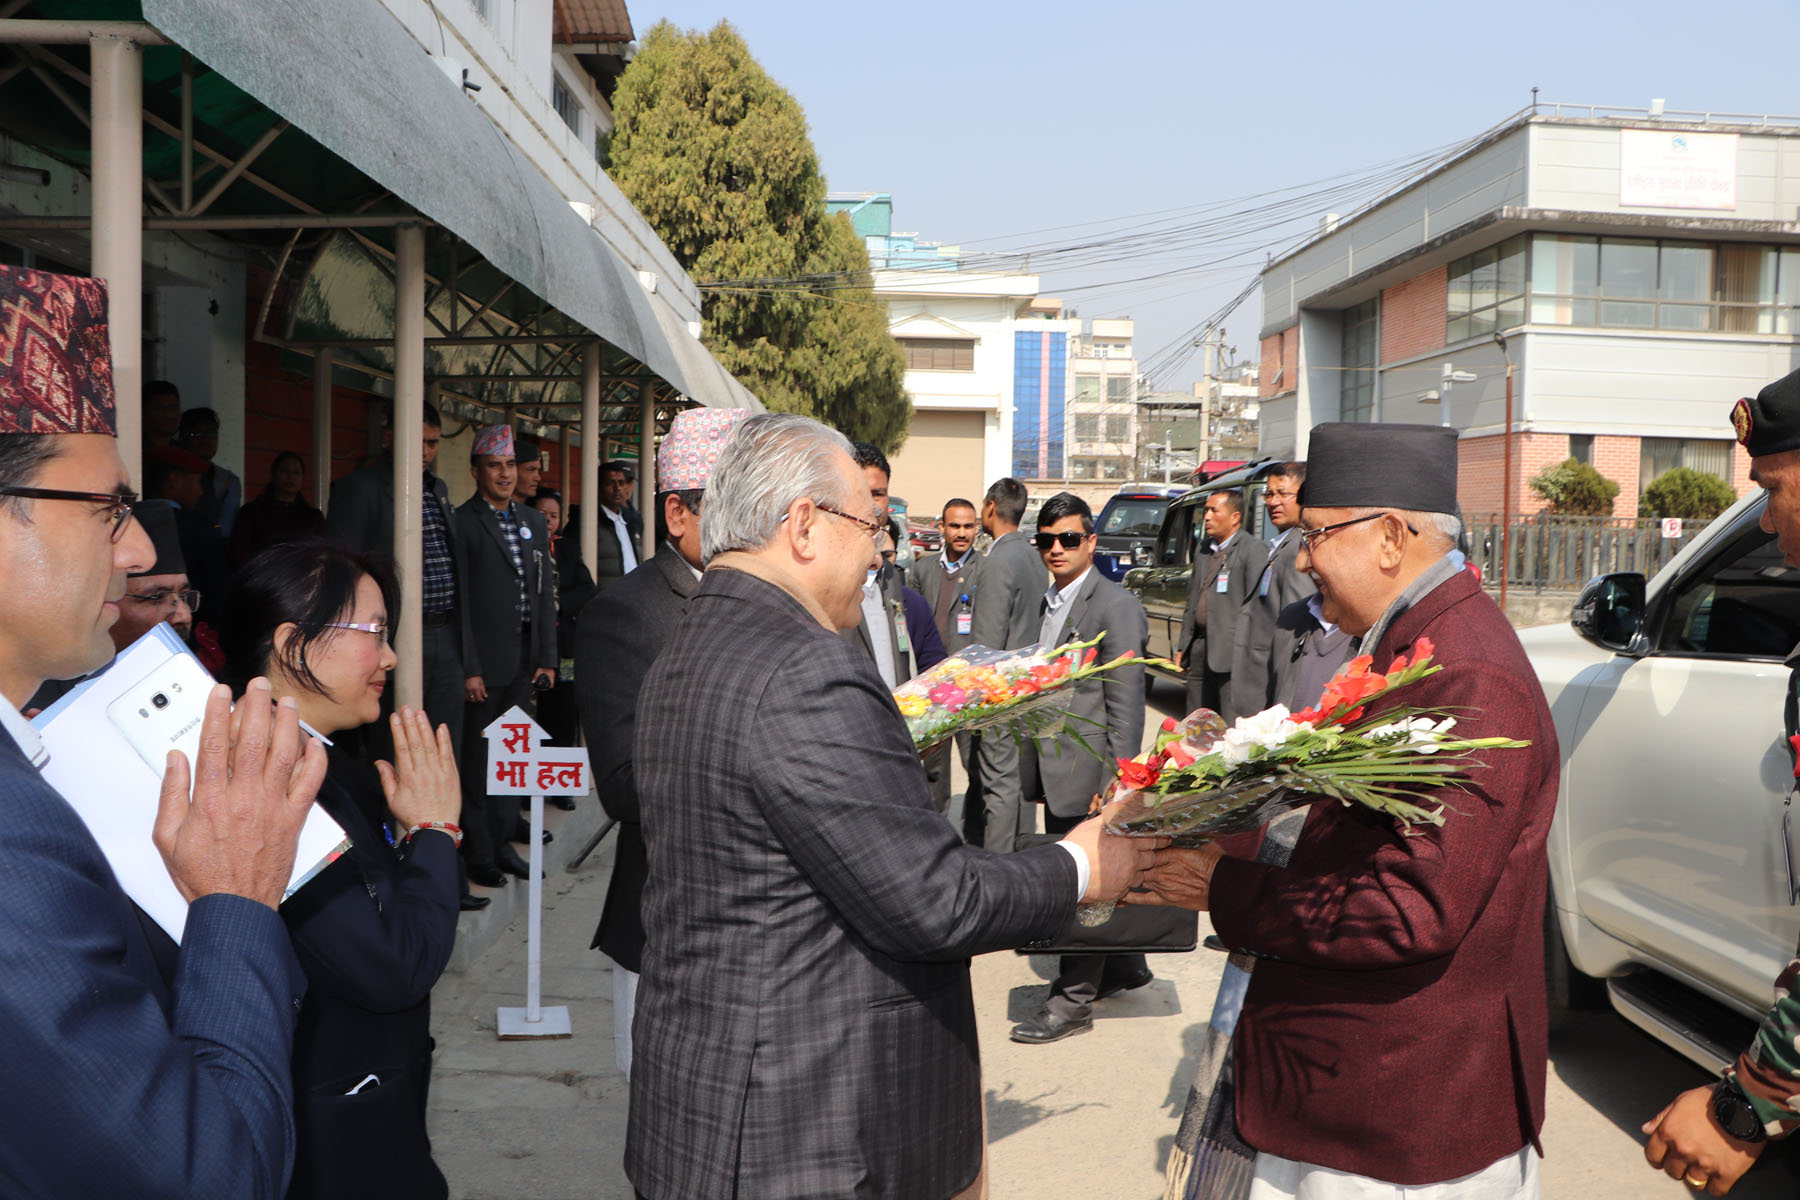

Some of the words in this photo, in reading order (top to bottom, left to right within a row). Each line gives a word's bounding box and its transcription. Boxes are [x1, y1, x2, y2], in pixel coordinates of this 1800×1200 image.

[170, 717, 201, 742] SAMSUNG
[501, 723, 531, 754] स
[496, 761, 529, 788] भा
[536, 761, 583, 790] हल
